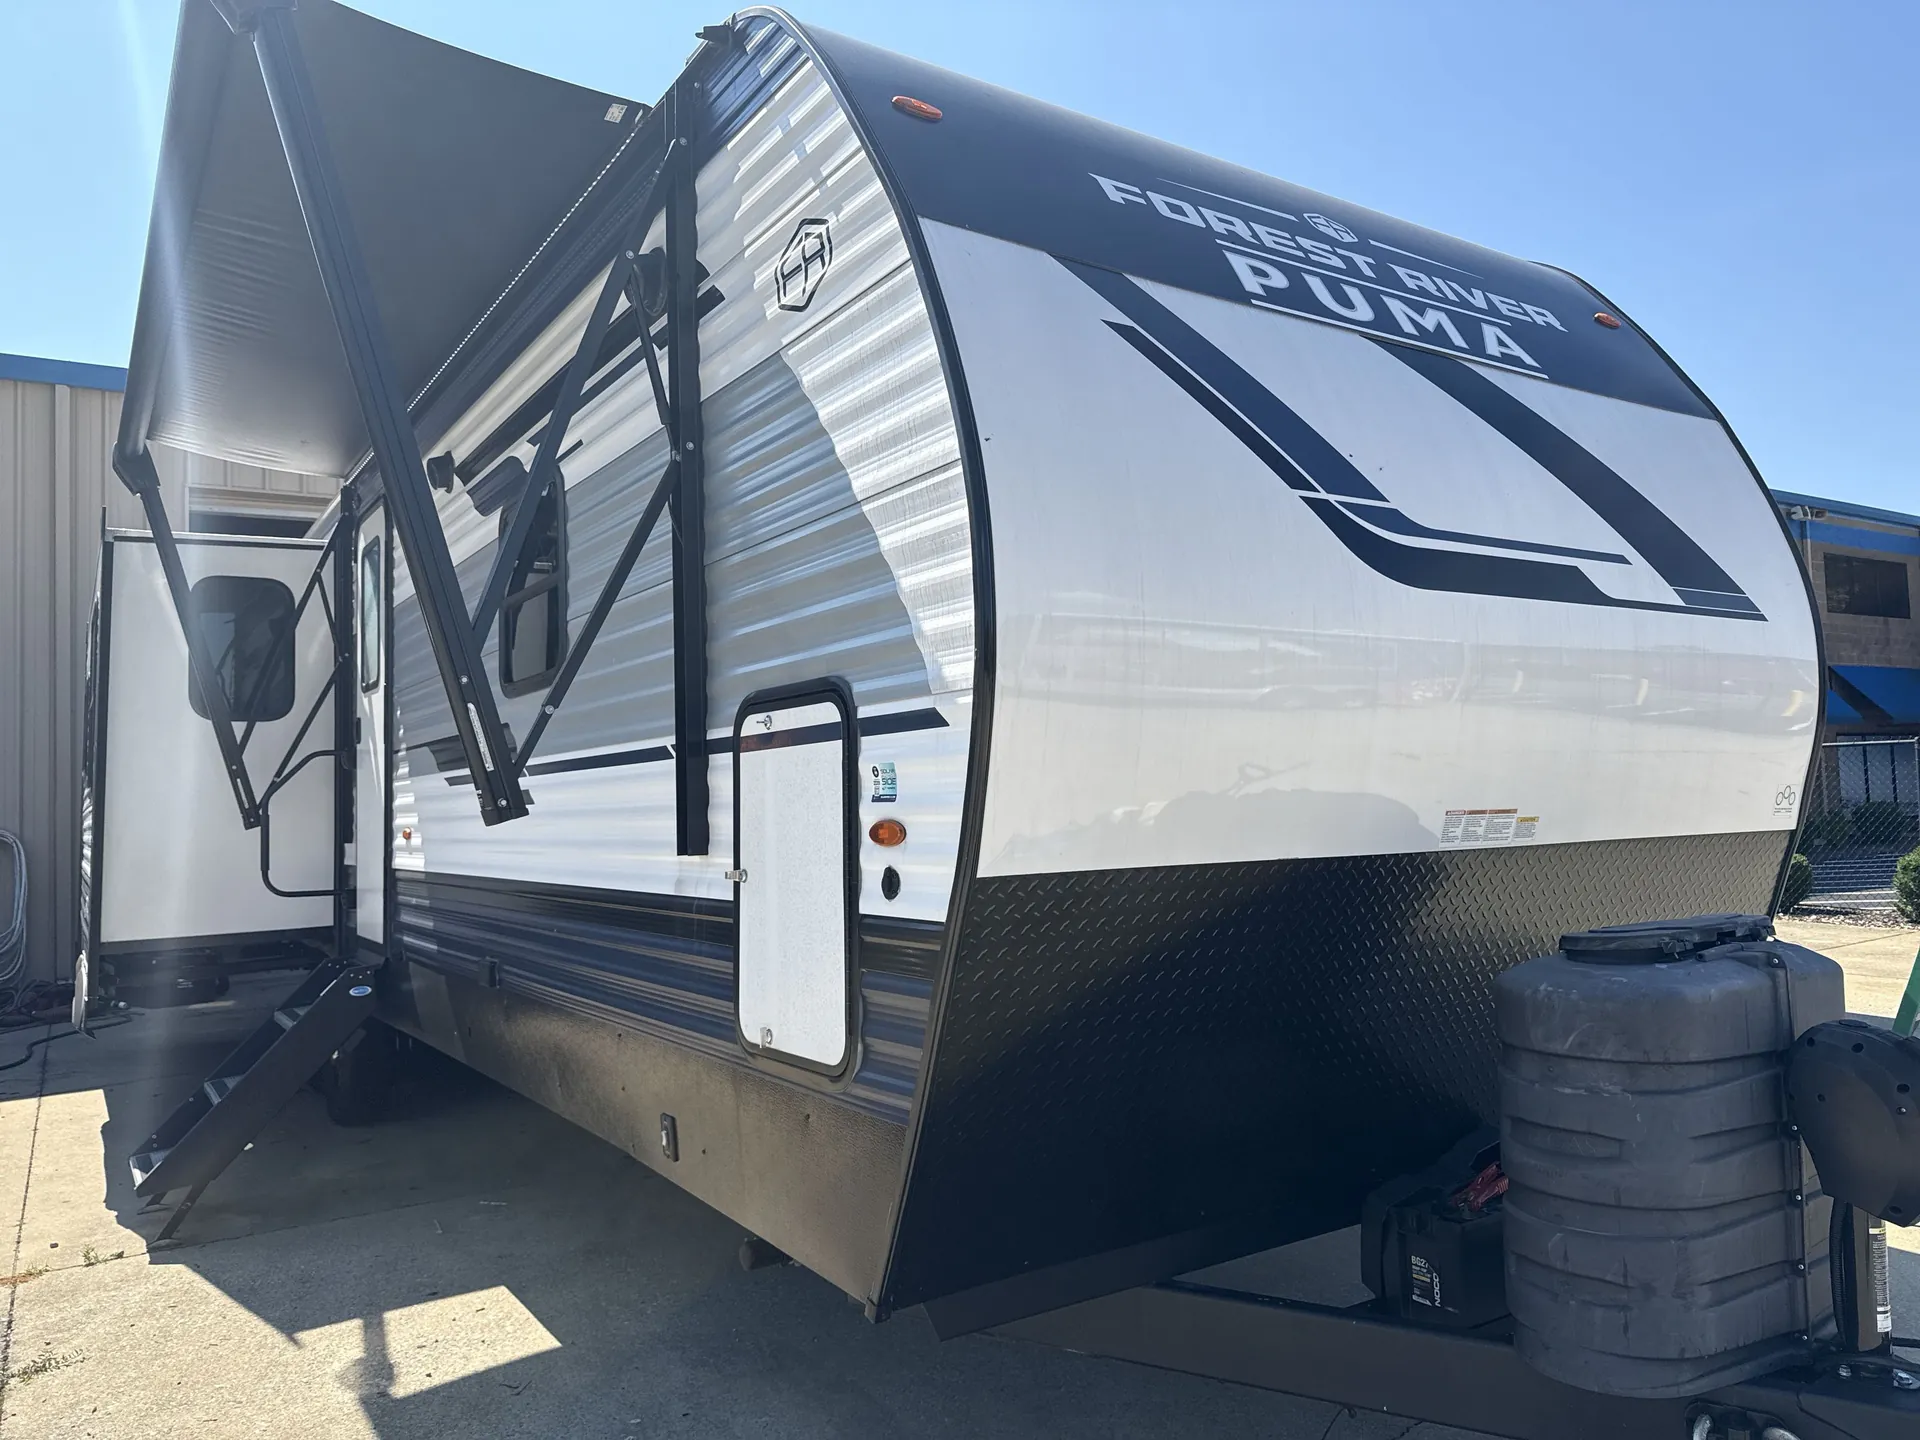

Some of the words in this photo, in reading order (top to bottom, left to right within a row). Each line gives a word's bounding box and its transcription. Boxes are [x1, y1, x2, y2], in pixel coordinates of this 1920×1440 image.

[1088, 173, 1376, 279] FOREST
[1387, 263, 1569, 333] RIVER
[1222, 249, 1542, 369] PUMA
[1433, 1272, 1441, 1307] NOCO
